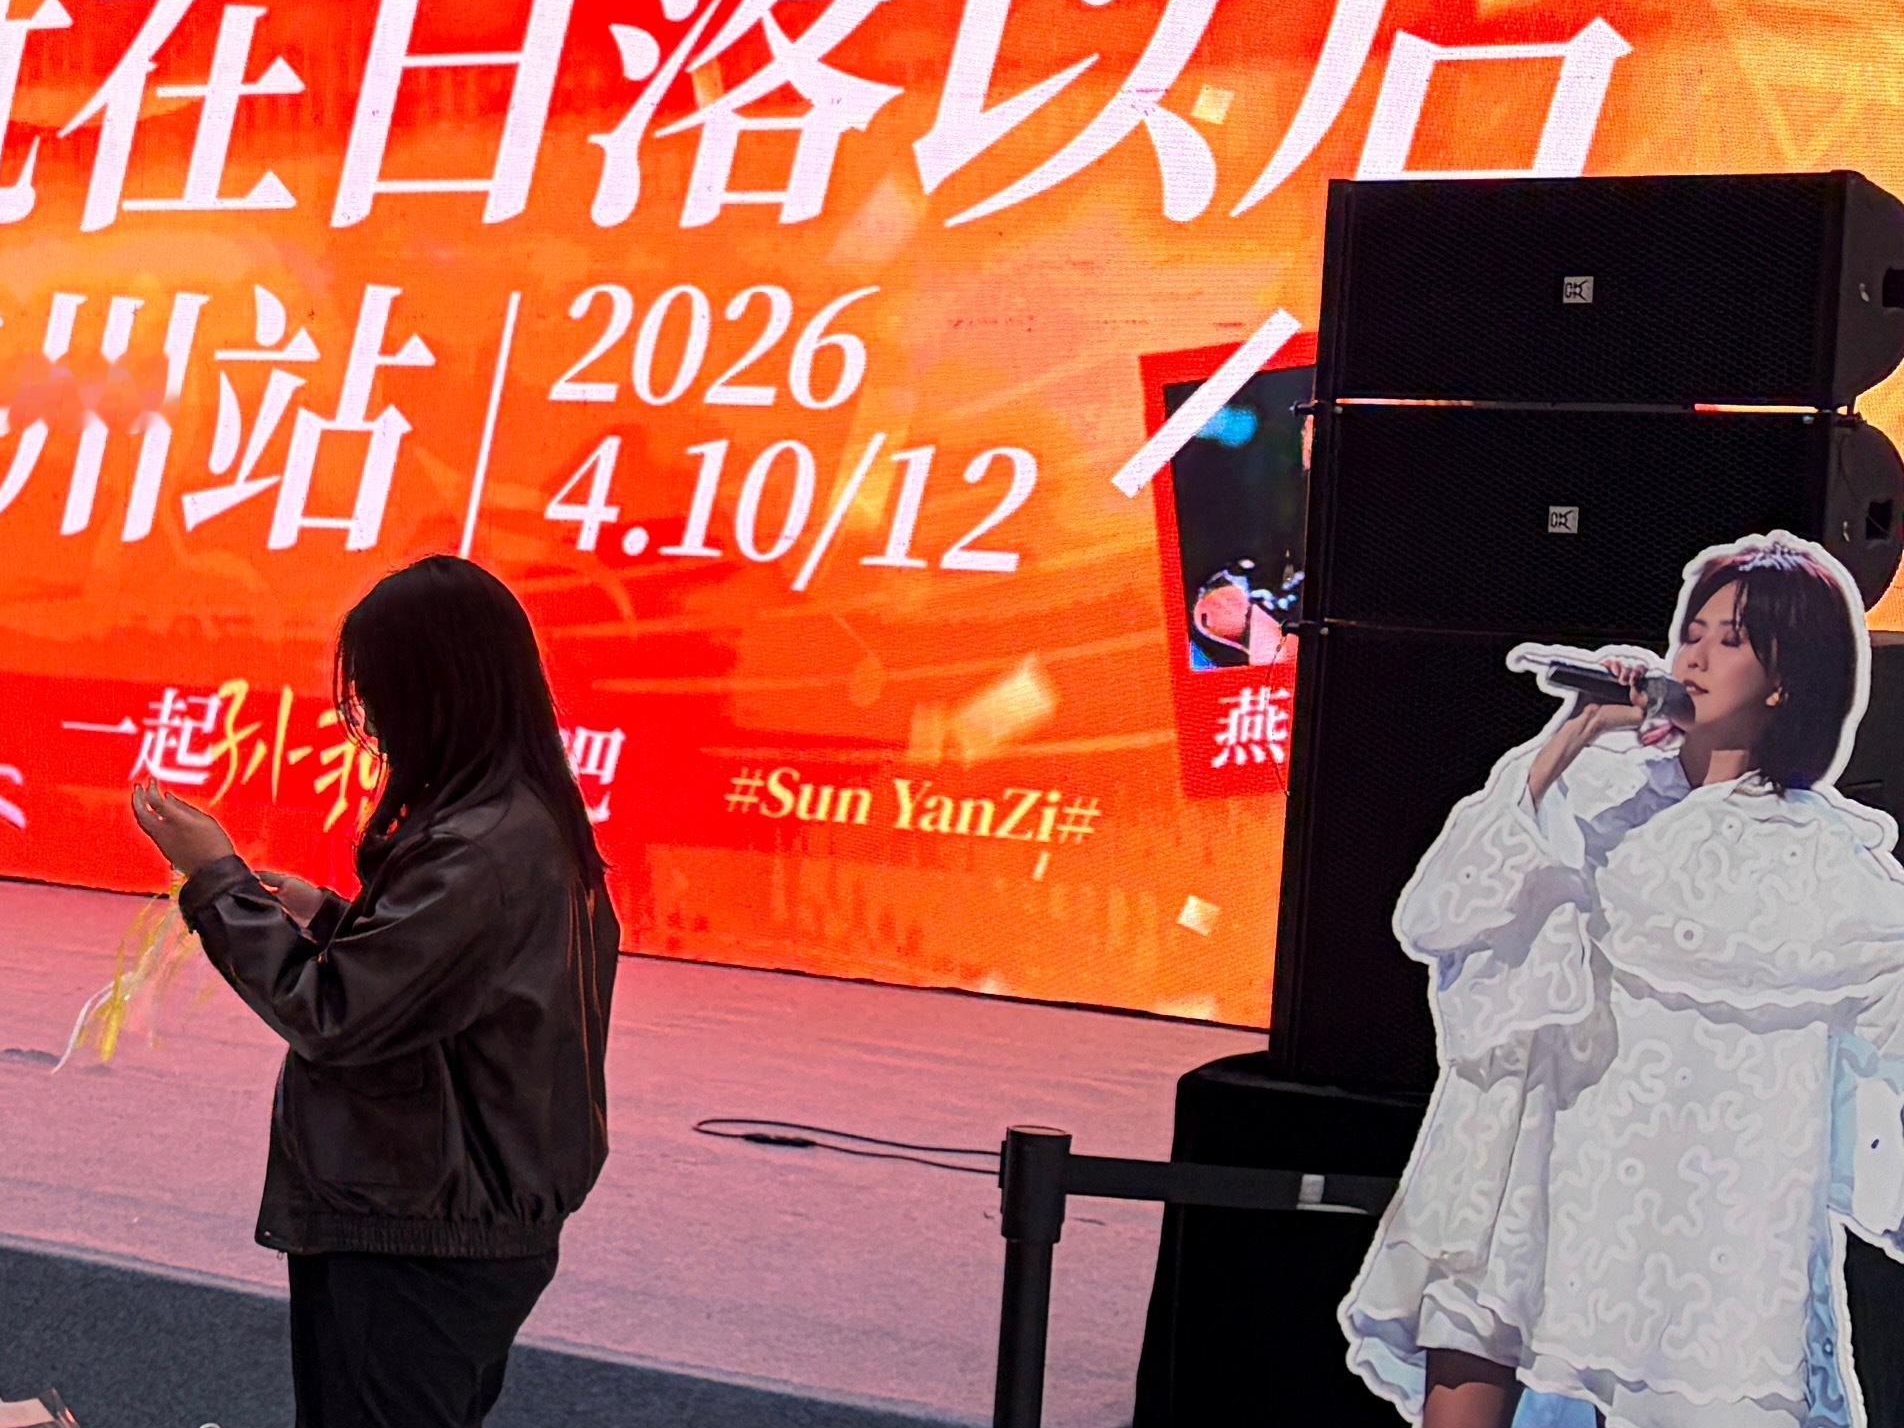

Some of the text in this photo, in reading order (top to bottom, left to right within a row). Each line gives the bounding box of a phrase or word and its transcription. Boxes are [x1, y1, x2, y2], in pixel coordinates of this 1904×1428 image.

[547, 283, 882, 410] 2026
[544, 433, 1040, 591] 4.10/12
[723, 766, 1102, 845] #Sun YanZi#
